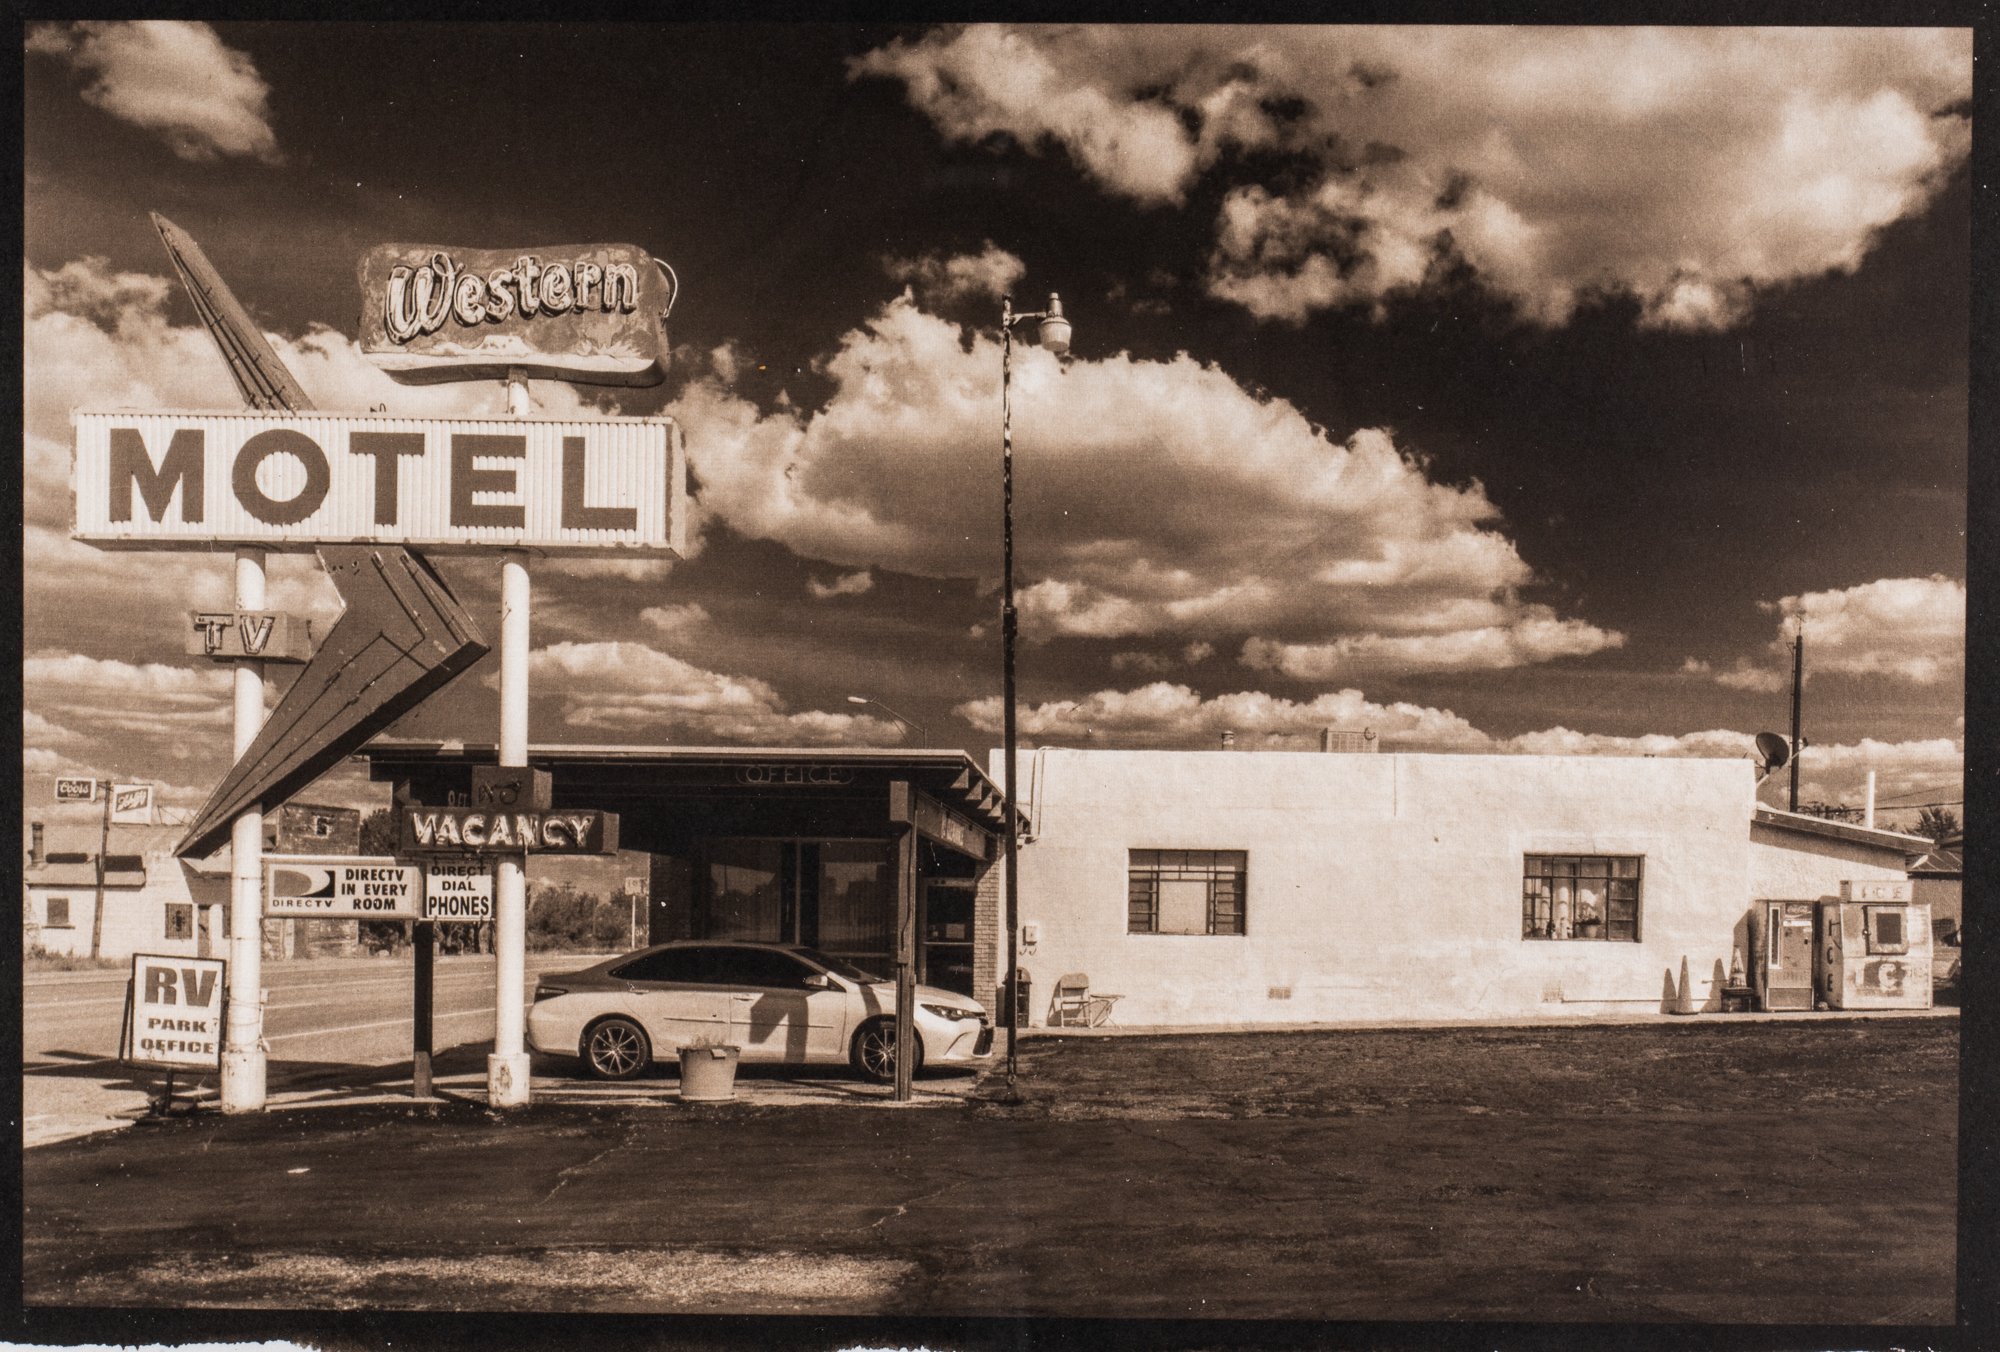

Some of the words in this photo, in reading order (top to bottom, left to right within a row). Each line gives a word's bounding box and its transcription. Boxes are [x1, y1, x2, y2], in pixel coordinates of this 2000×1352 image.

[384, 252, 639, 344] Western
[108, 428, 638, 530] MOTEL
[194, 614, 276, 655] TV
[411, 812, 596, 848] VACANCY
[345, 868, 405, 882] DIRECTV
[431, 866, 487, 877] DIRECT
[341, 883, 356, 896] IN
[363, 884, 408, 896] EVERY
[441, 880, 476, 892] DIAL
[272, 899, 334, 908] DIRECTV
[352, 897, 396, 911] ROOM
[428, 895, 490, 916] PHONES
[144, 965, 218, 1008] RV
[147, 1017, 207, 1033] PARK
[140, 1038, 214, 1055] OFFICE
